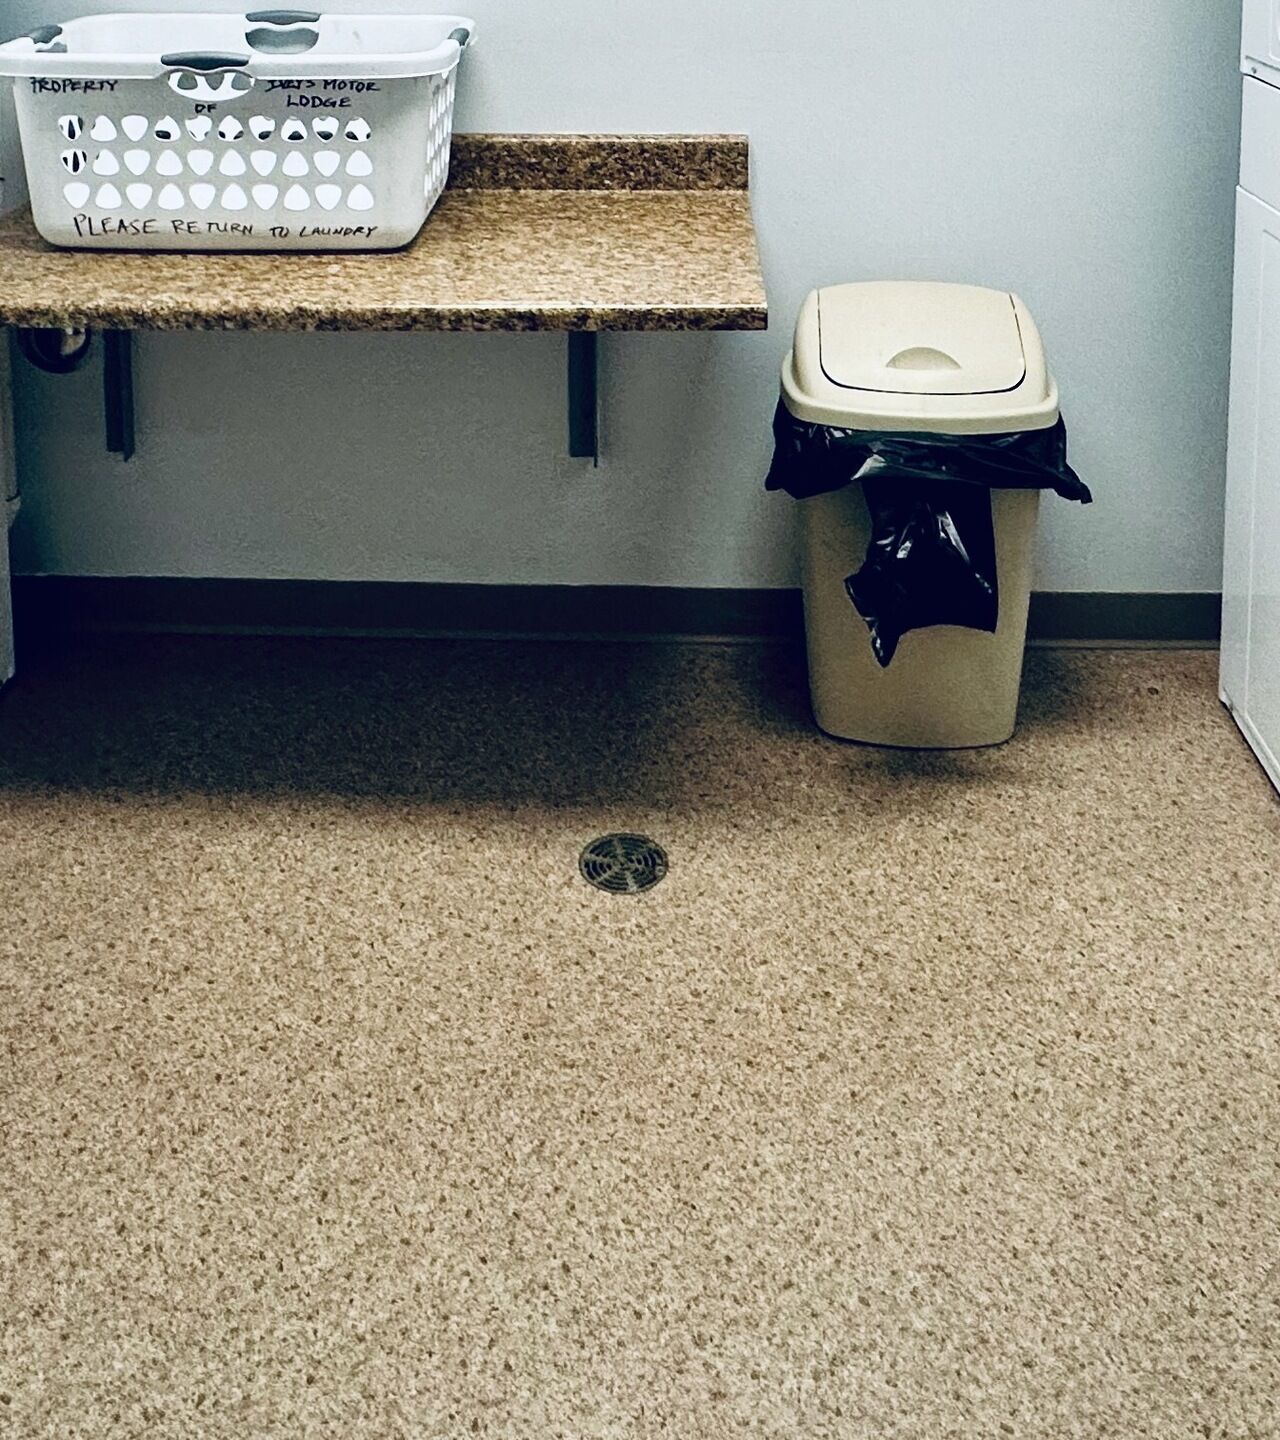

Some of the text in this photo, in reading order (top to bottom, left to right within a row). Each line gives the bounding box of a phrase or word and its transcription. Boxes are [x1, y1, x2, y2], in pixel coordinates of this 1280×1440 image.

[29, 76, 118, 93] PROPERTY
[323, 79, 381, 93] MOTOR
[195, 103, 217, 113] OF
[287, 95, 352, 108] LODGE
[73, 213, 378, 238] PLEASE RETURN TO LAUNDRY
